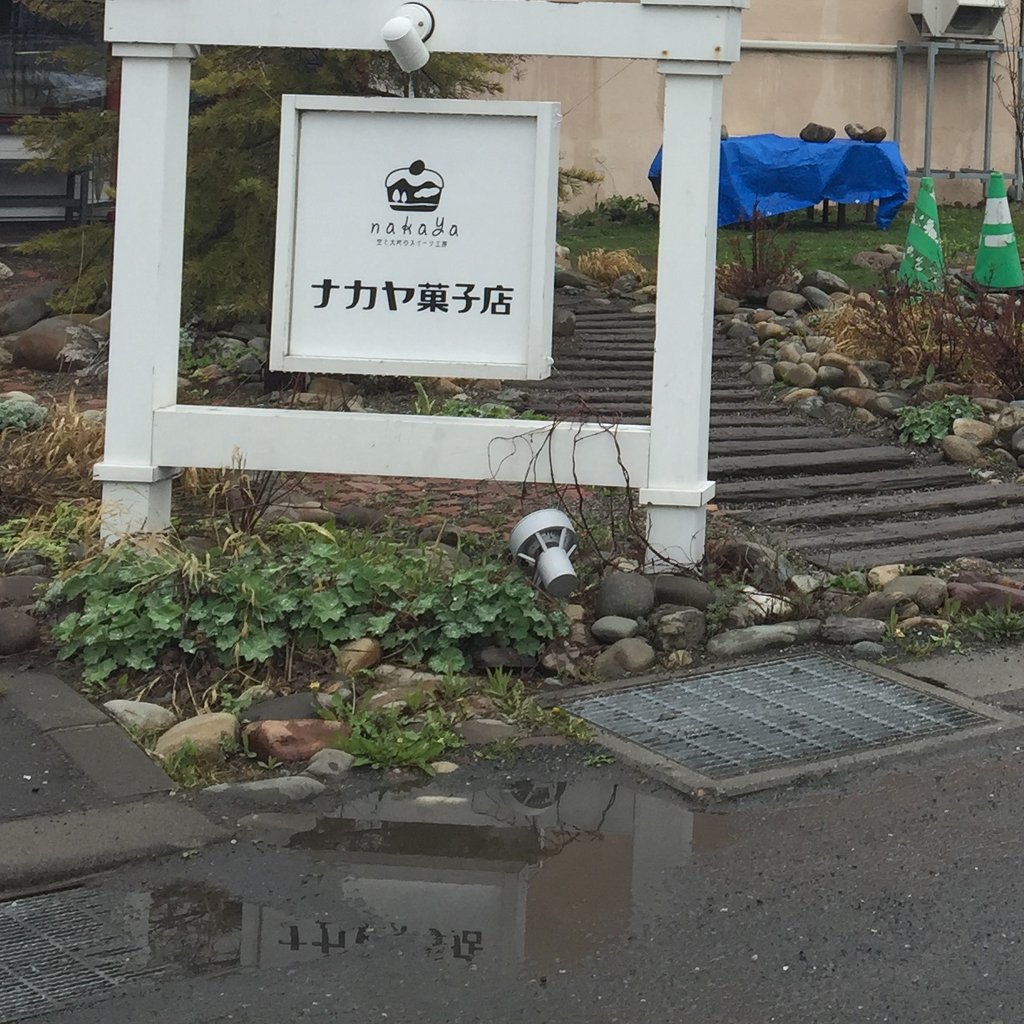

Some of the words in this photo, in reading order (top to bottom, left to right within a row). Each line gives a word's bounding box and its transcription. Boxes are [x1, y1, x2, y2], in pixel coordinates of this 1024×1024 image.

[371, 216, 458, 237] nakaya
[311, 279, 515, 315] ナカヤ菓子店
